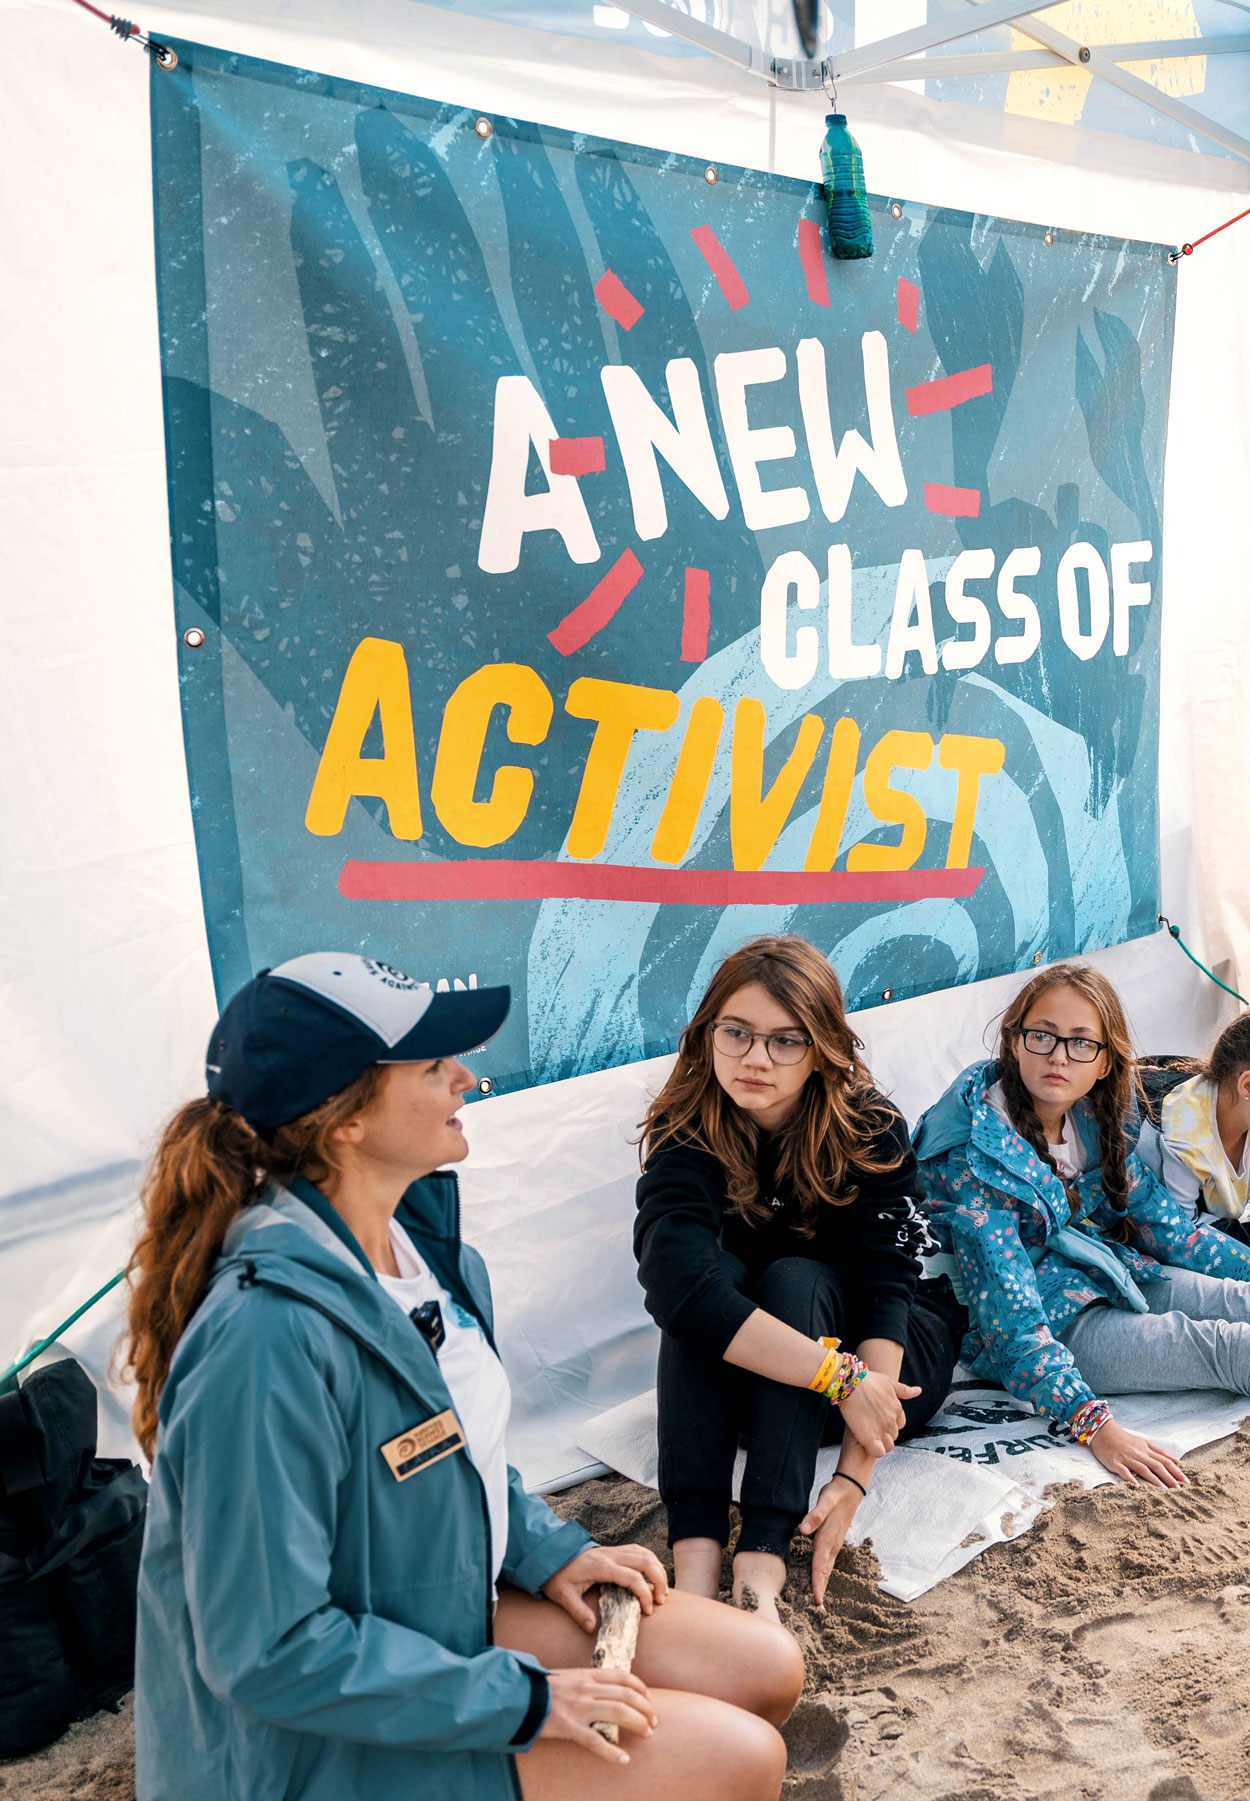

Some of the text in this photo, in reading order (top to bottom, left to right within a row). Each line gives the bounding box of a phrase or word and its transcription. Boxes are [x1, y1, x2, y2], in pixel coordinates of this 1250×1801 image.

[478, 331, 908, 574] A NEW
[760, 540, 1153, 690] CLASS OF
[304, 636, 1006, 873] ACTIVIST
